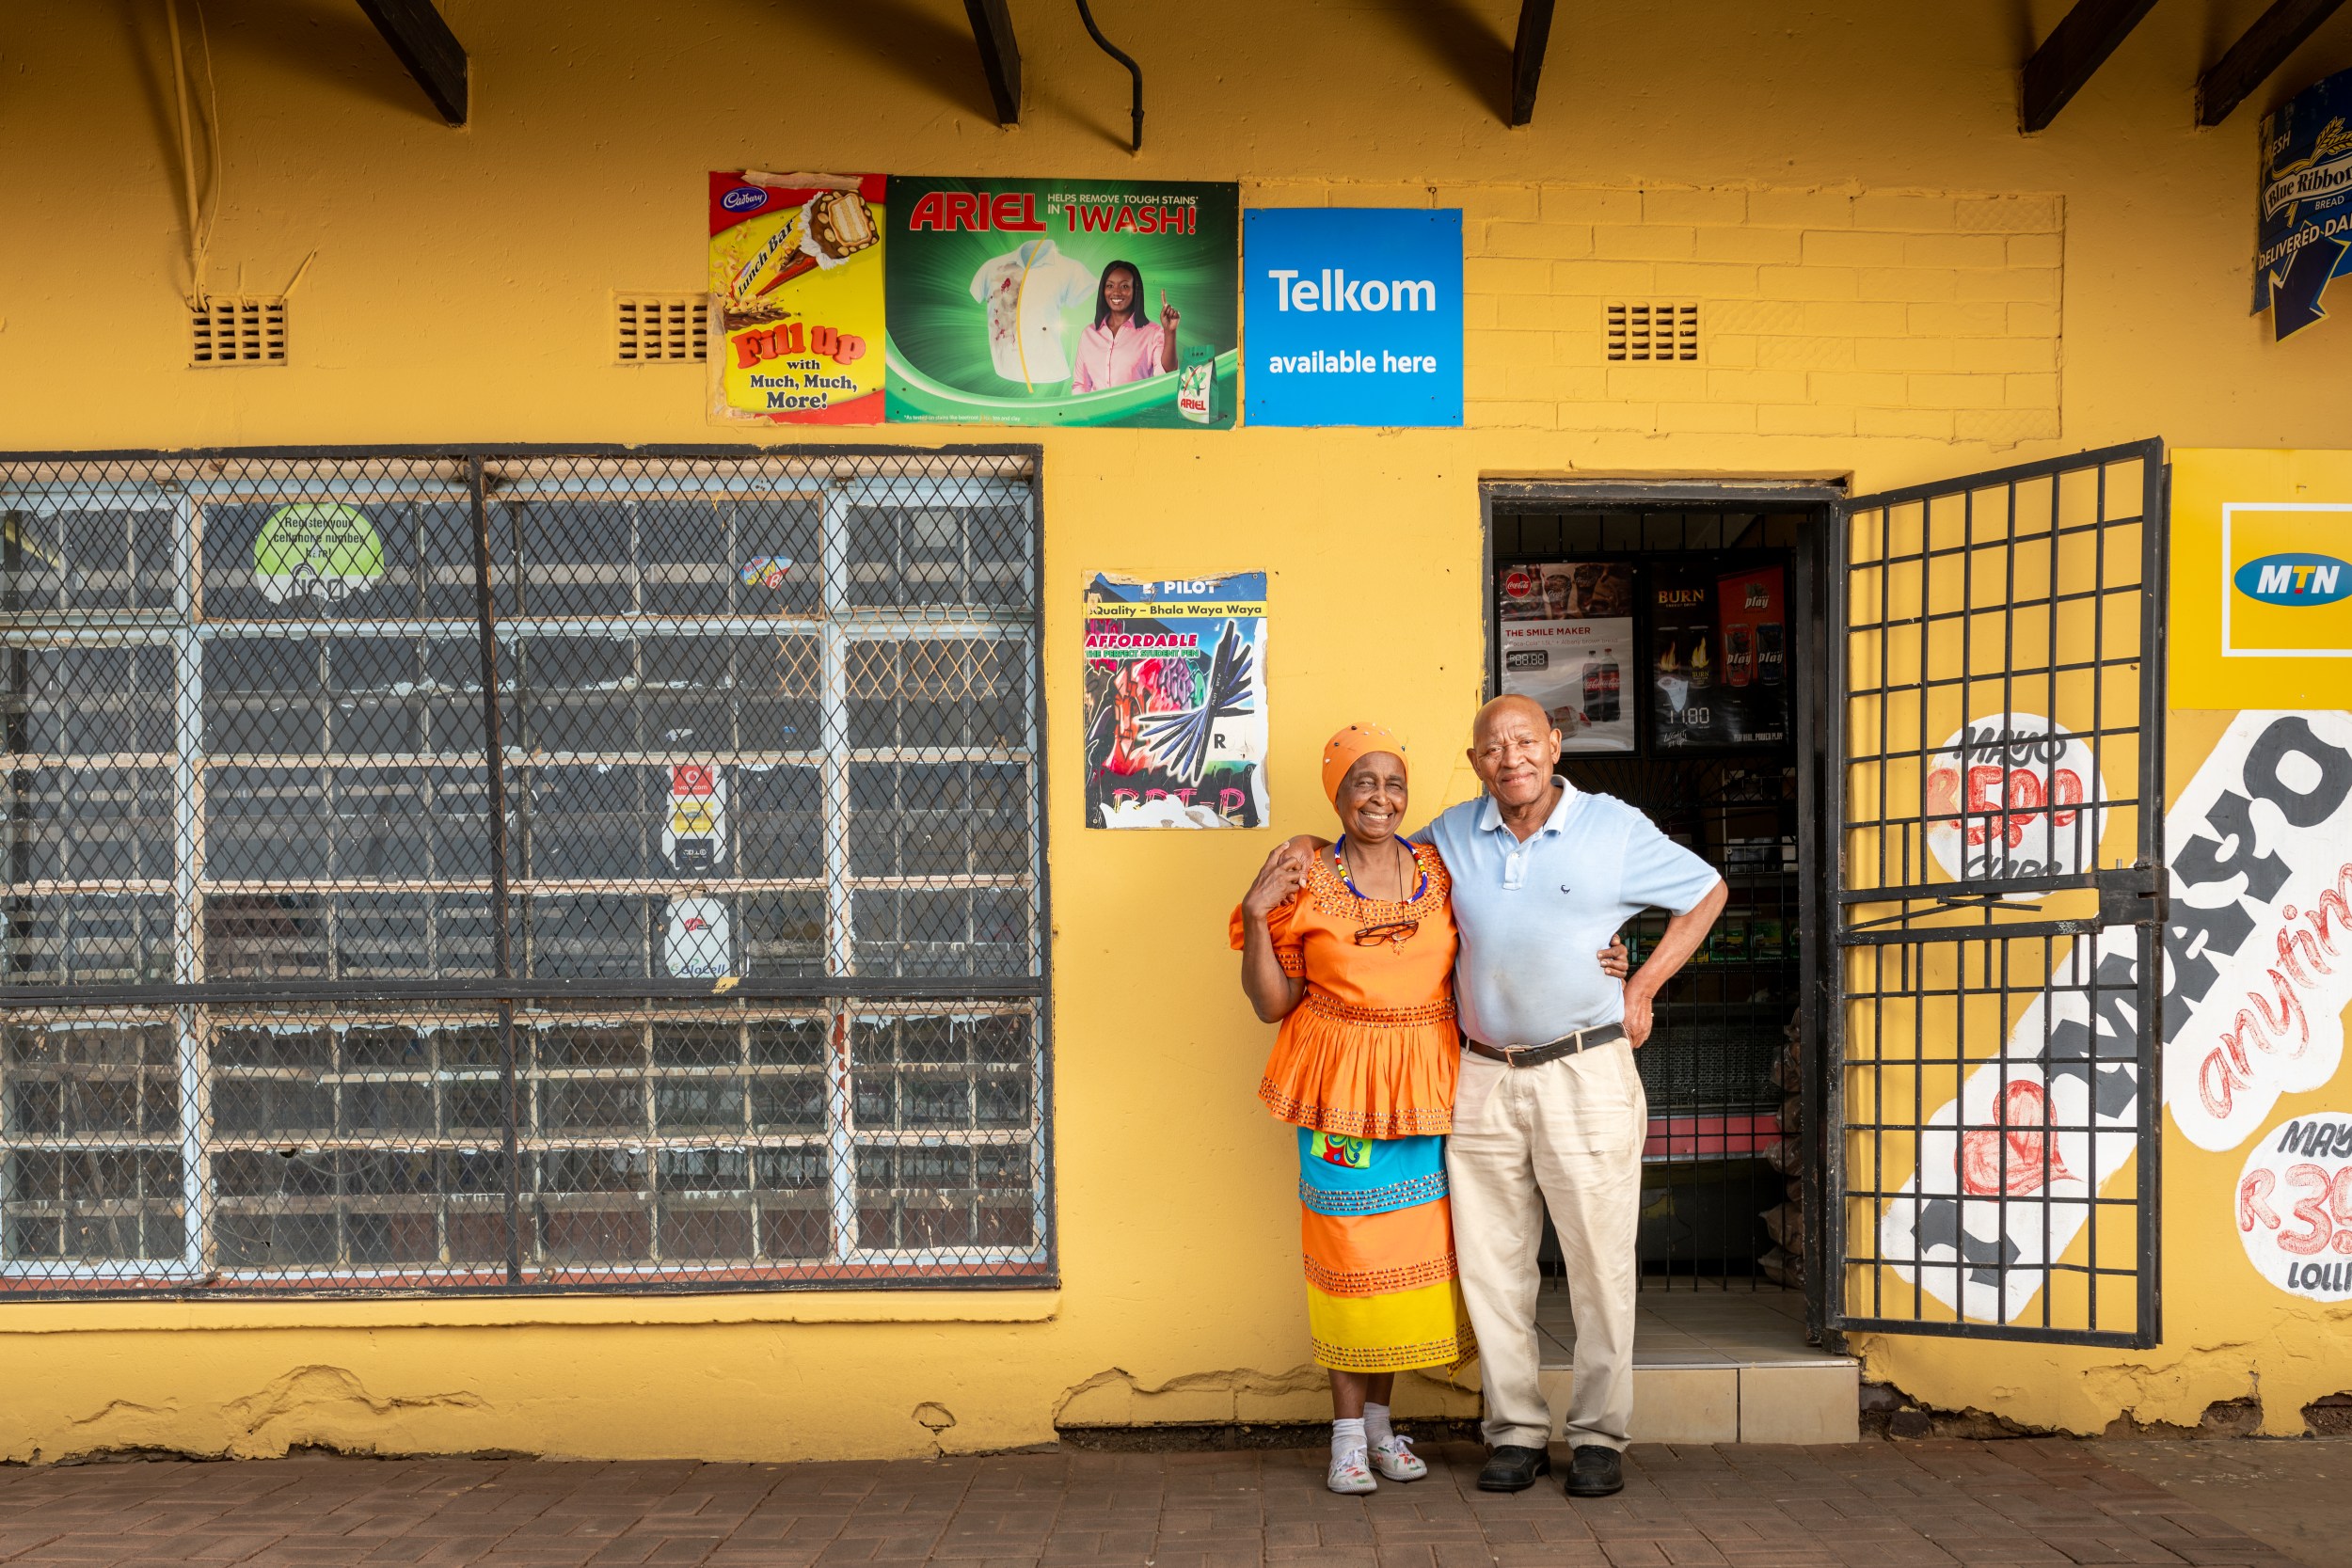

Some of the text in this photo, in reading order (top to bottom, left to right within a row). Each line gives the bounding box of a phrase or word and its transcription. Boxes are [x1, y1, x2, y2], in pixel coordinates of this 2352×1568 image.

[723, 191, 764, 207] Cadbury
[1047, 194, 1076, 202] HELPS
[1079, 195, 1120, 203] REMOVE
[1123, 195, 1159, 204] TOUGH
[2268, 180, 2294, 207] Blue
[1047, 204, 1060, 214] IN
[2314, 196, 2344, 211] BREAD
[910, 192, 1047, 232] ARIEL
[2259, 225, 2320, 271] DELIVERED
[739, 218, 794, 296] Lunch Bar
[1268, 268, 1437, 312] Telkom
[731, 323, 866, 369] Fill up
[787, 359, 820, 371] with
[1269, 349, 1437, 373] available here
[751, 374, 857, 391] Much, Much,
[766, 392, 828, 409] More!
[1180, 398, 1206, 411] ARIEL
[285, 517, 327, 530] Register
[274, 532, 364, 544] cellphone number
[2256, 564, 2341, 594] MTN
[1164, 580, 1222, 594] PILOT
[1658, 589, 1705, 604] BURN
[1150, 605, 1183, 615] Bhala
[1187, 604, 1222, 617] Waya
[1227, 604, 1262, 616] Waya
[1526, 628, 1554, 637] SMILE
[1556, 626, 1591, 636] MAKER
[1086, 634, 1198, 647] AFFORDABLE
[1104, 649, 1138, 657] PERFECT
[1140, 649, 1180, 657] STUDENT
[1181, 649, 1199, 657] PEN
[1215, 734, 1226, 749] R
